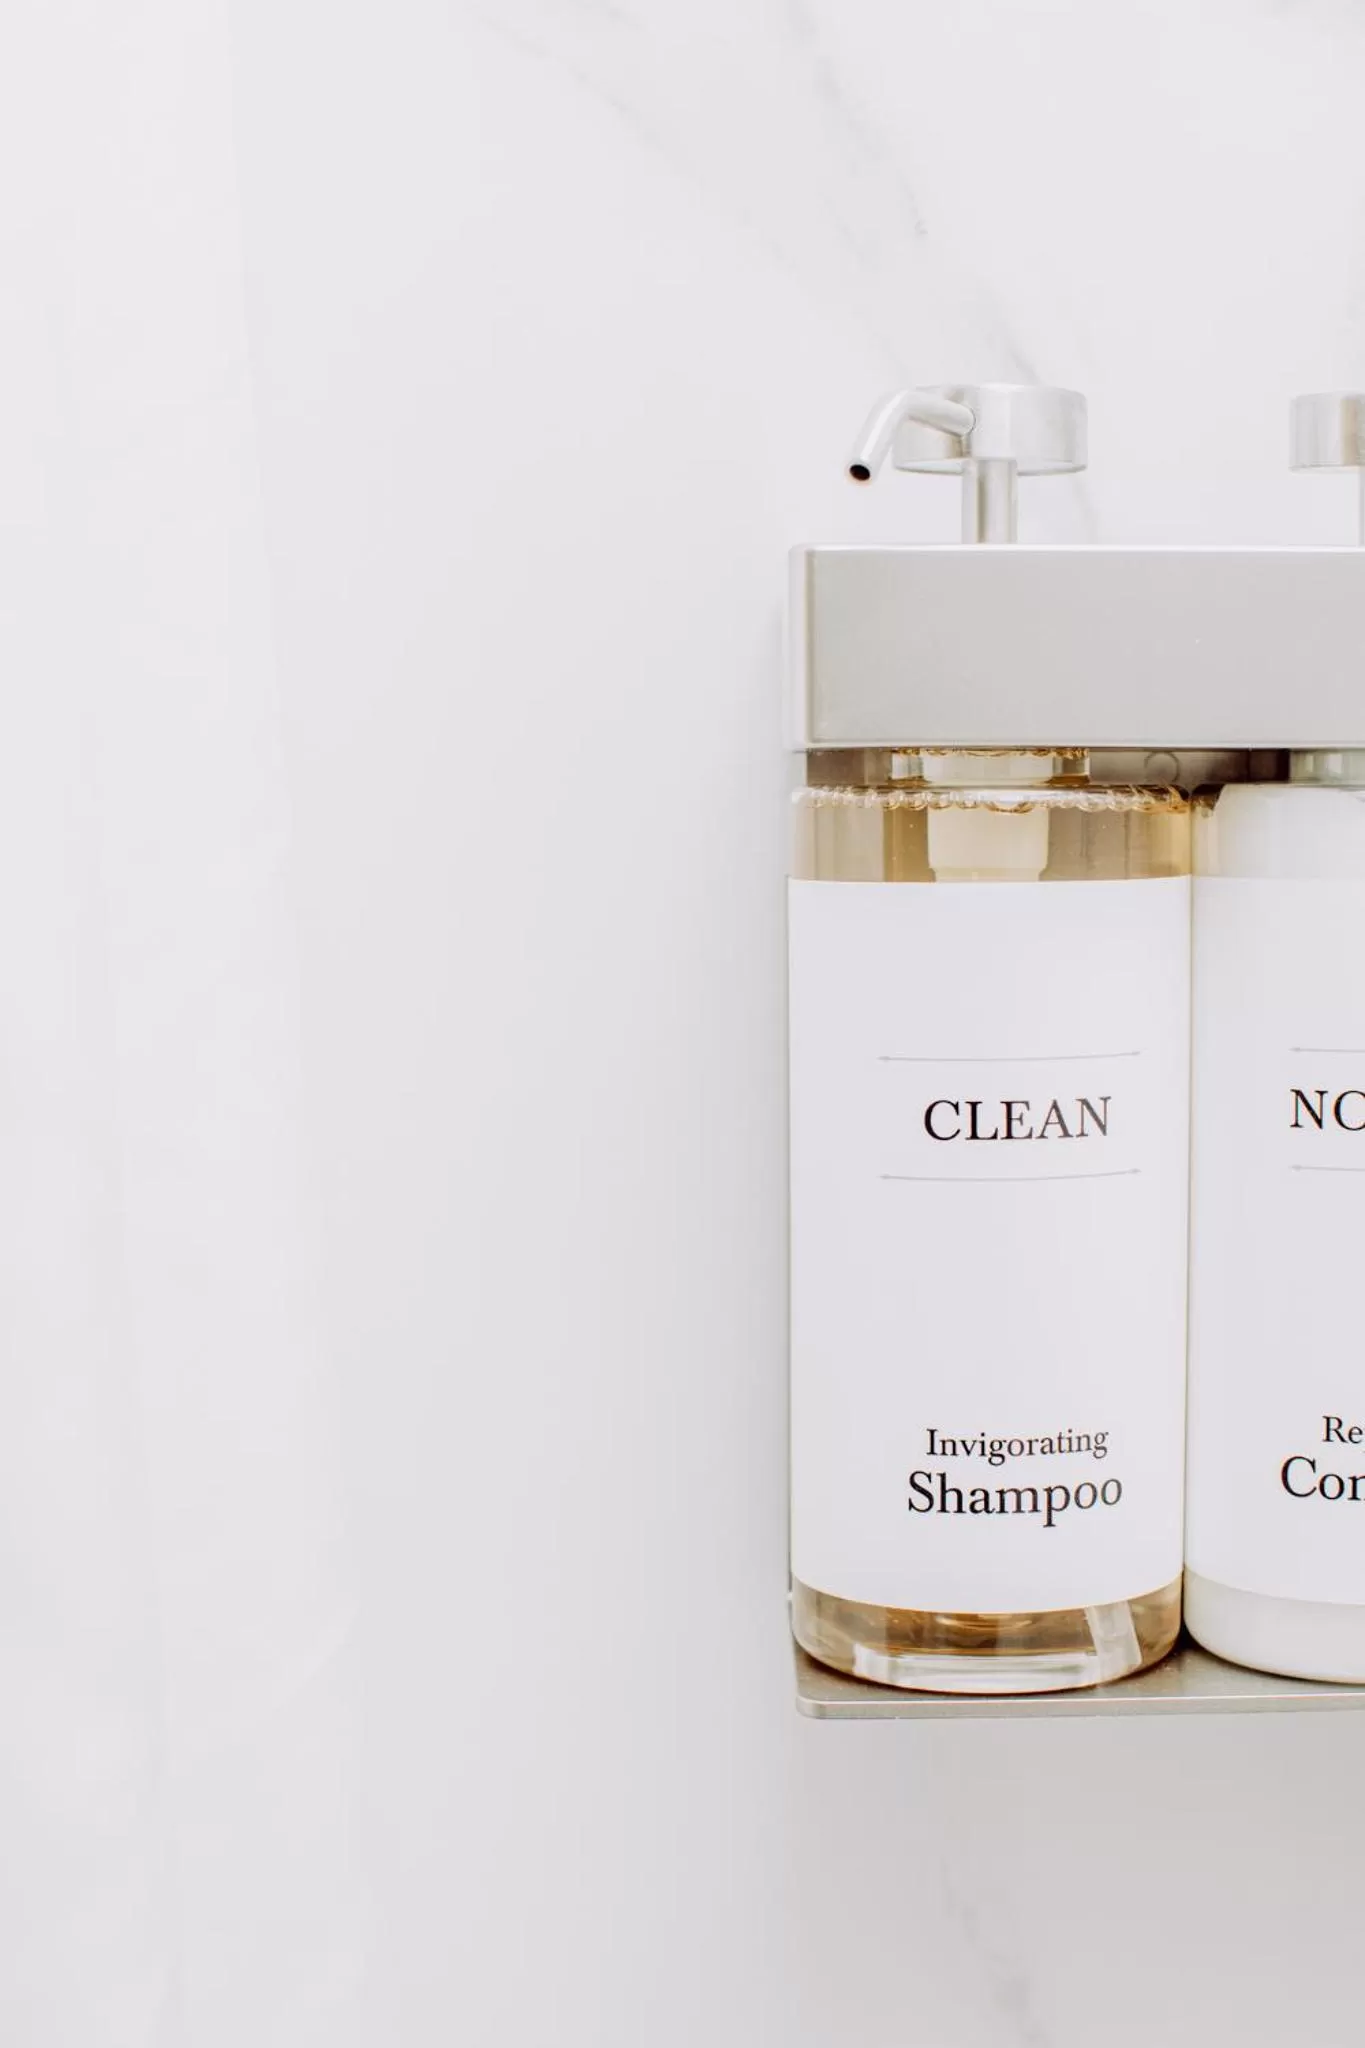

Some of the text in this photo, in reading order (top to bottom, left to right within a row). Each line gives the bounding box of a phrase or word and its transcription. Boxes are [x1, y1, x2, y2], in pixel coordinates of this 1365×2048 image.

[922, 1094, 1112, 1142] CLEAN
[924, 1427, 1109, 1466] Invigorating
[906, 1470, 1123, 1528] Shampoo
